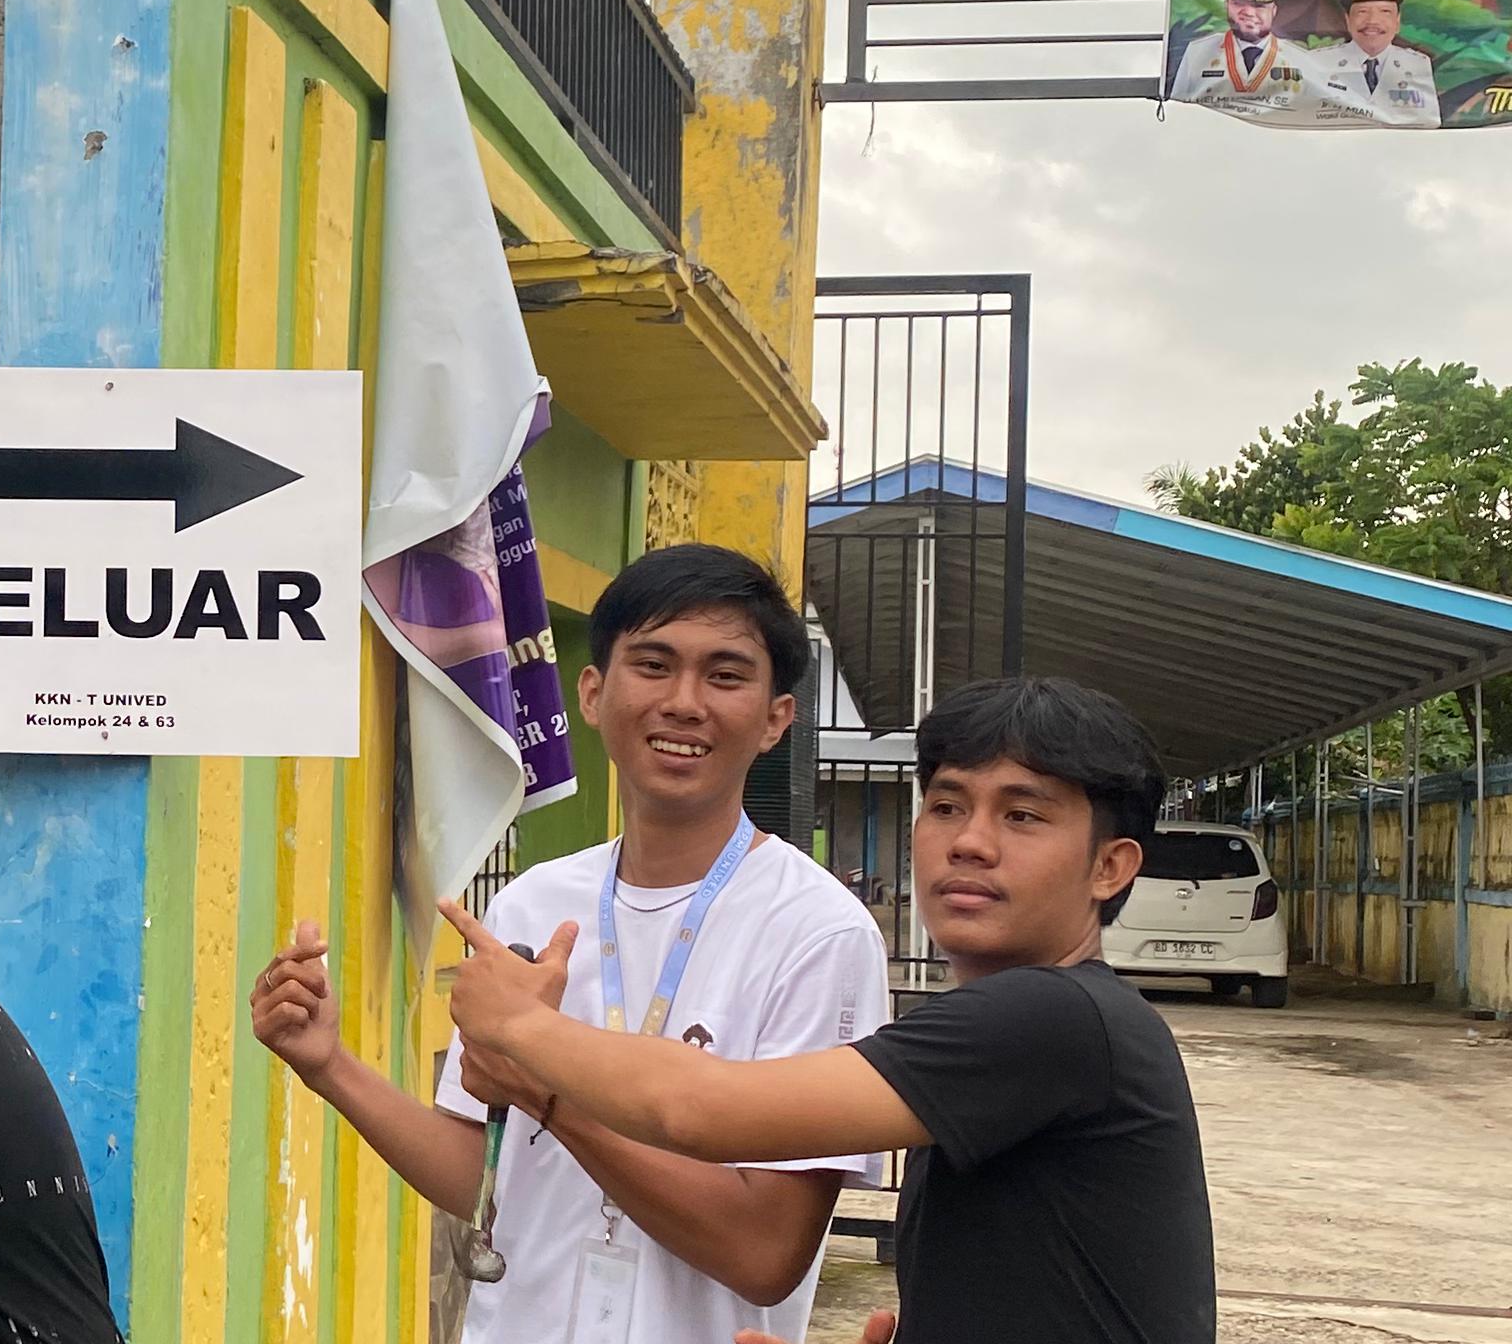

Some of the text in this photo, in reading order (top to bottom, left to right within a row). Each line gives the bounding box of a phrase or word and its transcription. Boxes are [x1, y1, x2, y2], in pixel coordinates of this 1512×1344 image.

[35, 693, 71, 705] KKN
[88, 694, 97, 705] T
[103, 695, 167, 706] UNIVED
[26, 714, 175, 729] Kelompok 24 & 63
[701, 851, 739, 898] UNIVED
